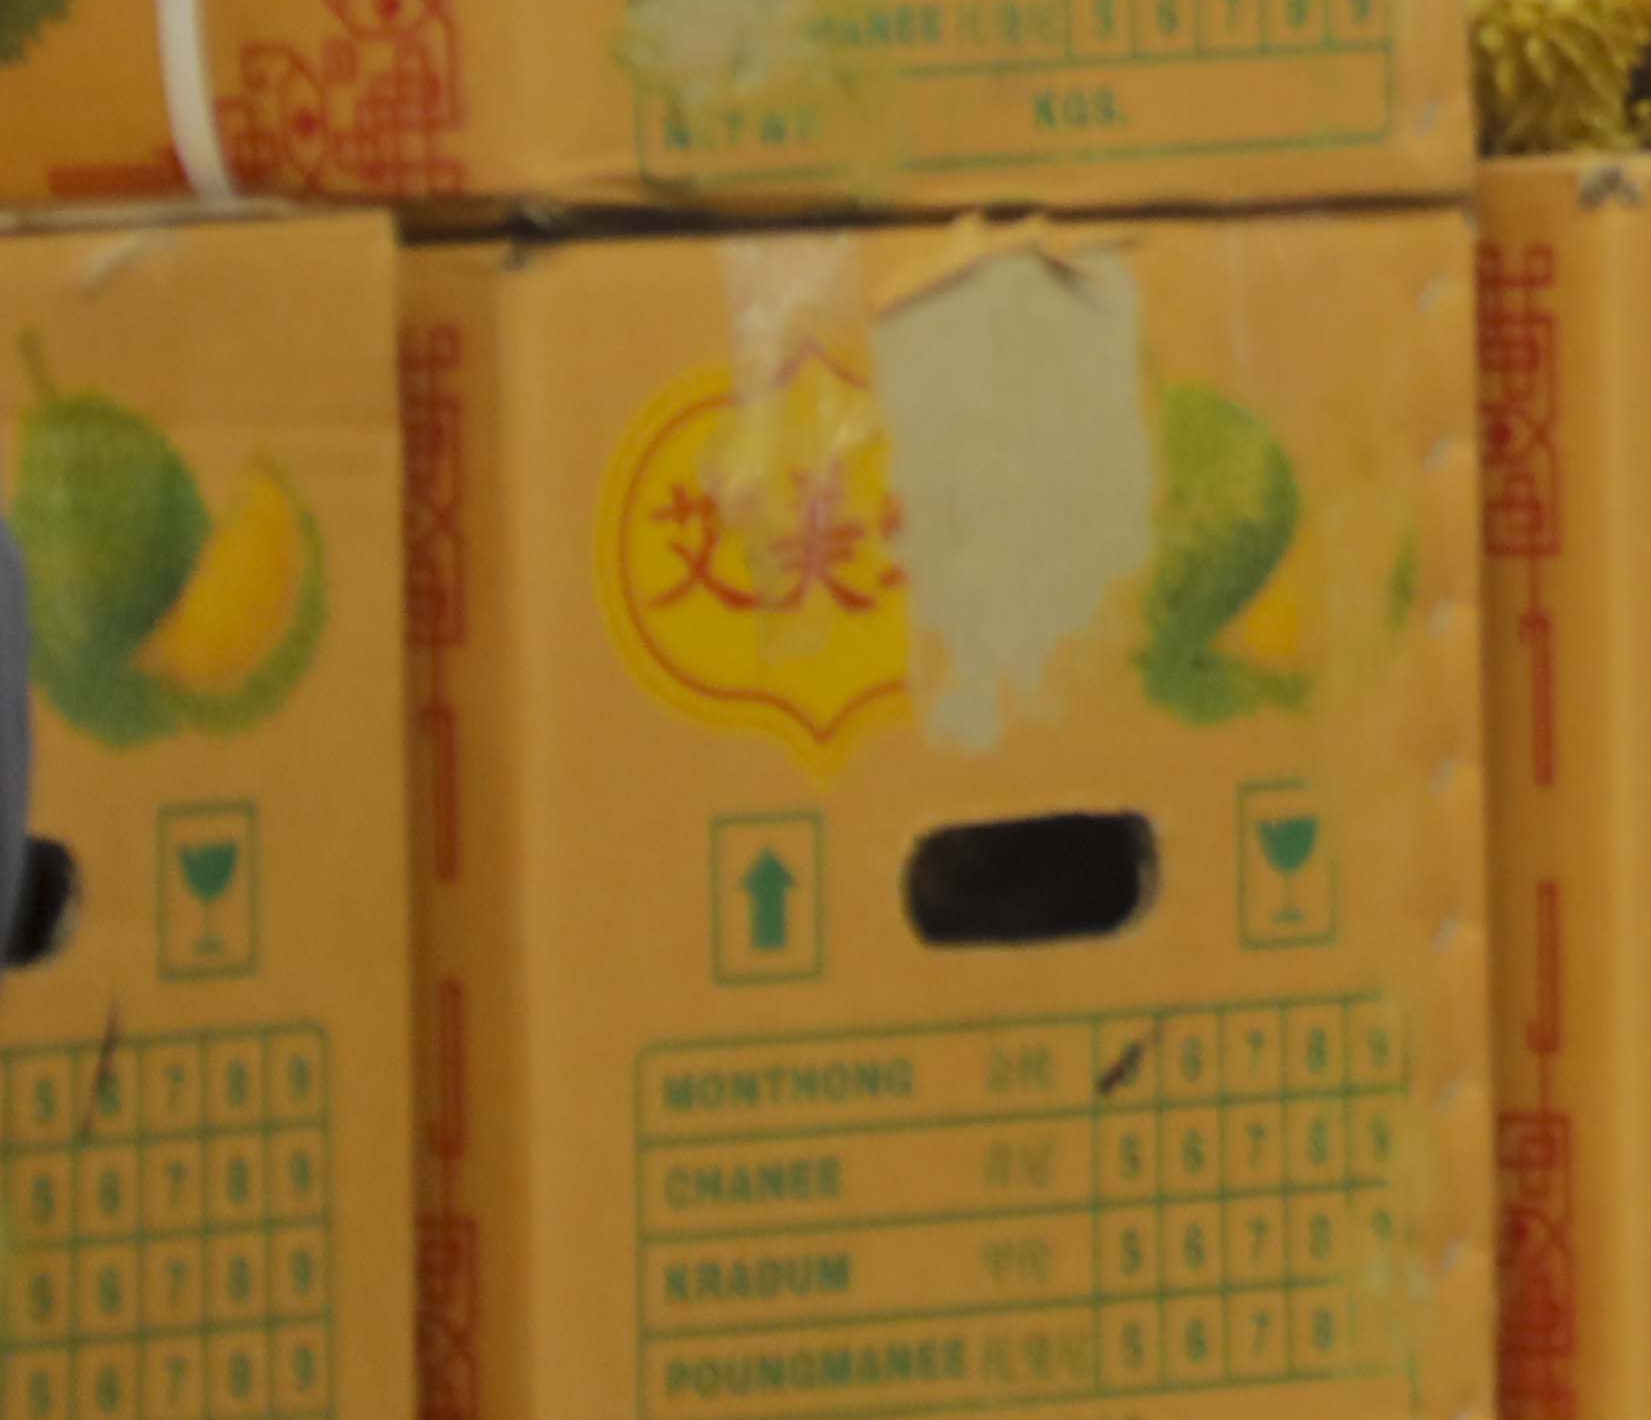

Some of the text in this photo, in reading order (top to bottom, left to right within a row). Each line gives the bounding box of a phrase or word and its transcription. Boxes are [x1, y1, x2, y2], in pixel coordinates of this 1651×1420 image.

[650, 461, 905, 615] 艾美
[664, 1057, 914, 1113] MONTHONG
[664, 1157, 840, 1211] CHANEE
[665, 1251, 850, 1304] KRADUM
[667, 1337, 966, 1398] POUNGMANEE
